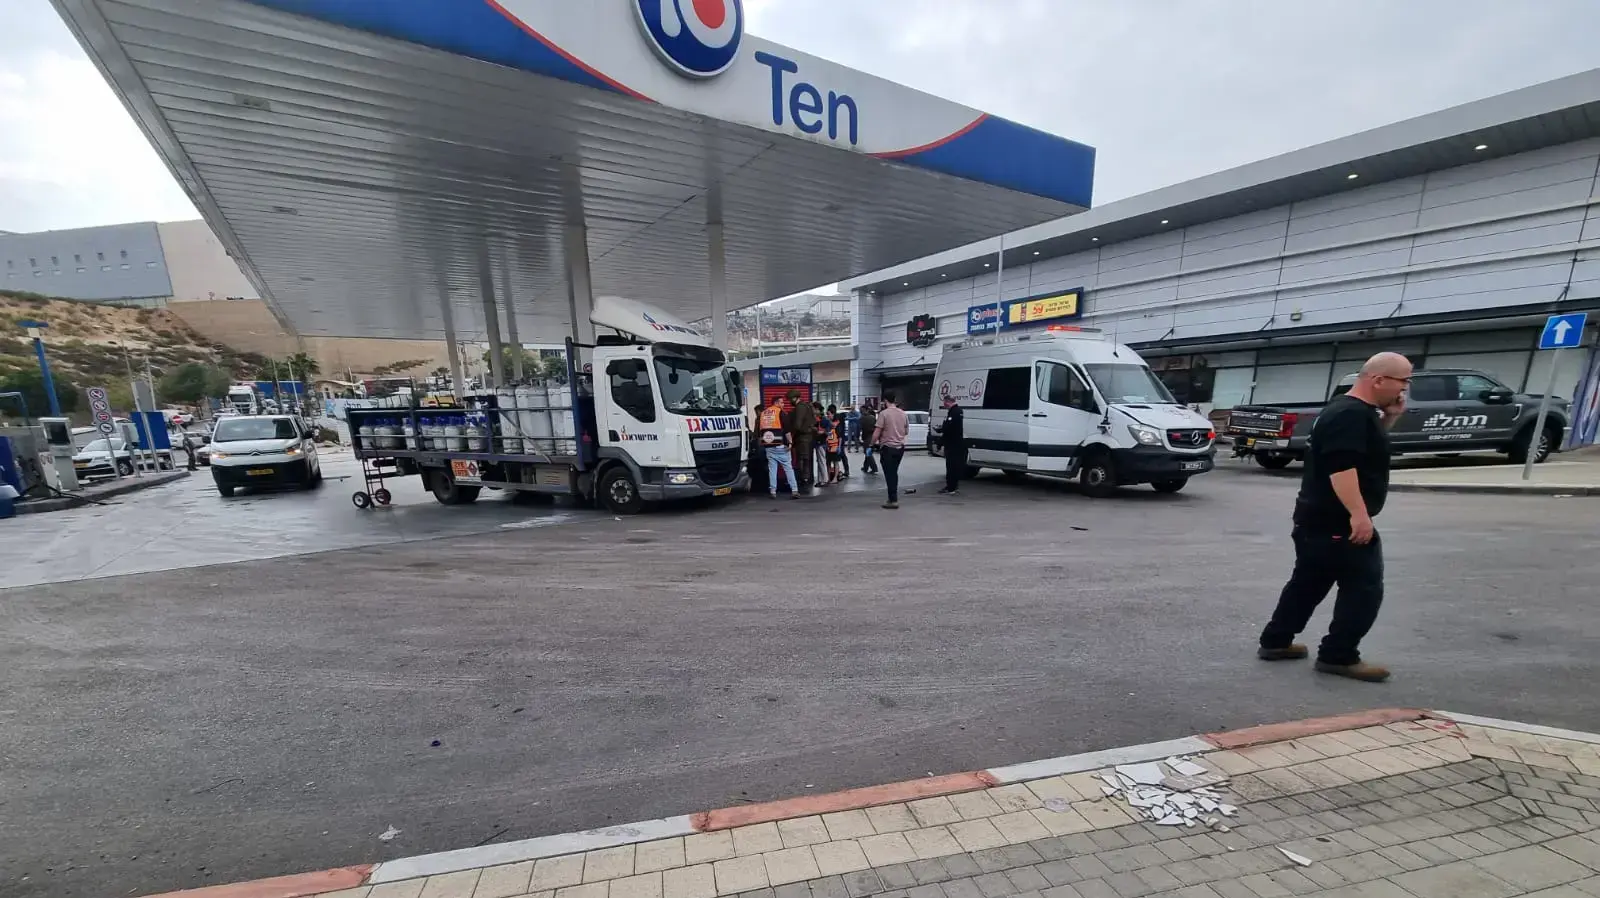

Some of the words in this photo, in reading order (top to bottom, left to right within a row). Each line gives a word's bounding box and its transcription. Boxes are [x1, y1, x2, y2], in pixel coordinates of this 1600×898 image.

[754, 50, 858, 145] Ten
[685, 416, 742, 432] אמישראגז
[711, 441, 729, 449] DAF
